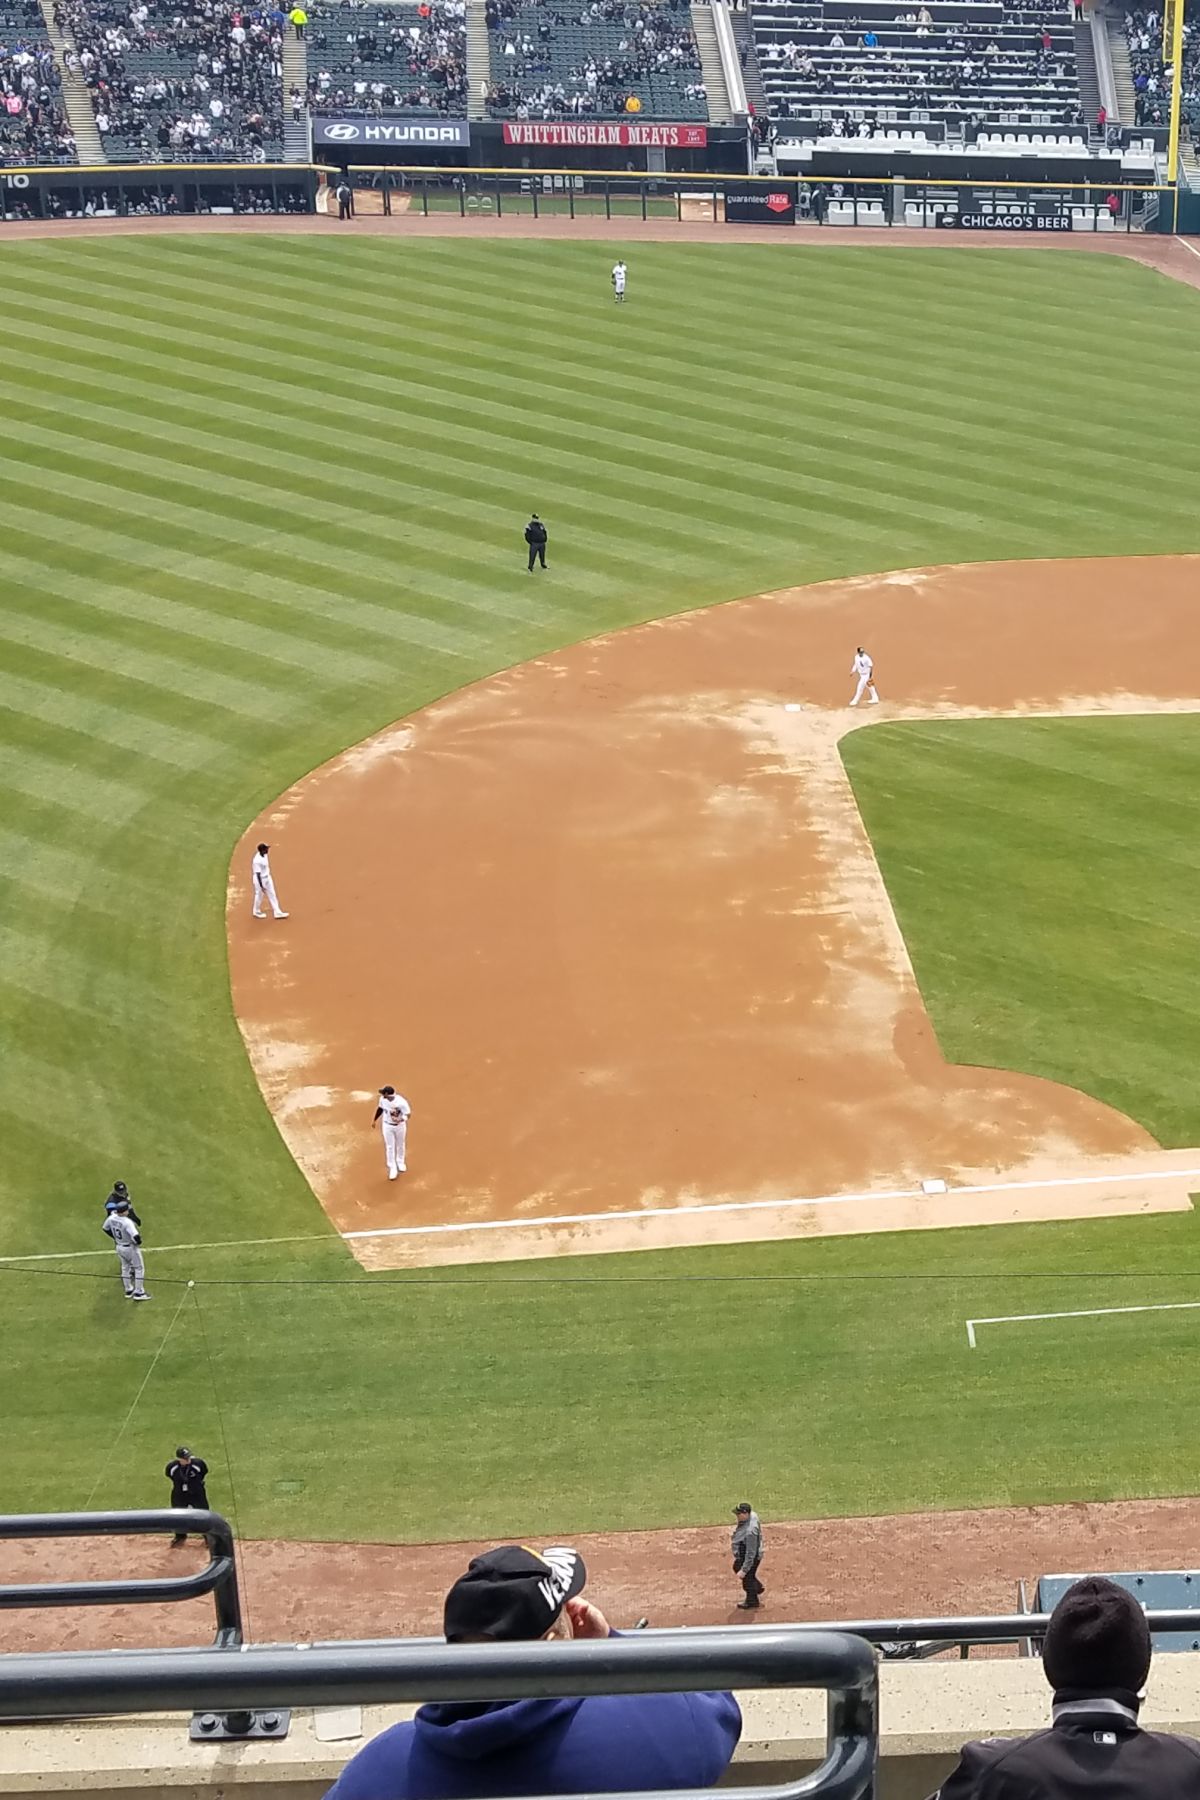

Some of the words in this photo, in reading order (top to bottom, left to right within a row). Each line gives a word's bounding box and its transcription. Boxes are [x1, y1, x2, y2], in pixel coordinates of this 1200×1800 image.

[365, 126, 461, 141] HYUNDAI
[508, 124, 621, 144] WHITTINGHAM
[627, 126, 679, 146] MEATS
[1142, 191, 1158, 200] 335
[961, 215, 1033, 228] CHICAGO'S
[1037, 217, 1069, 229] BEER
